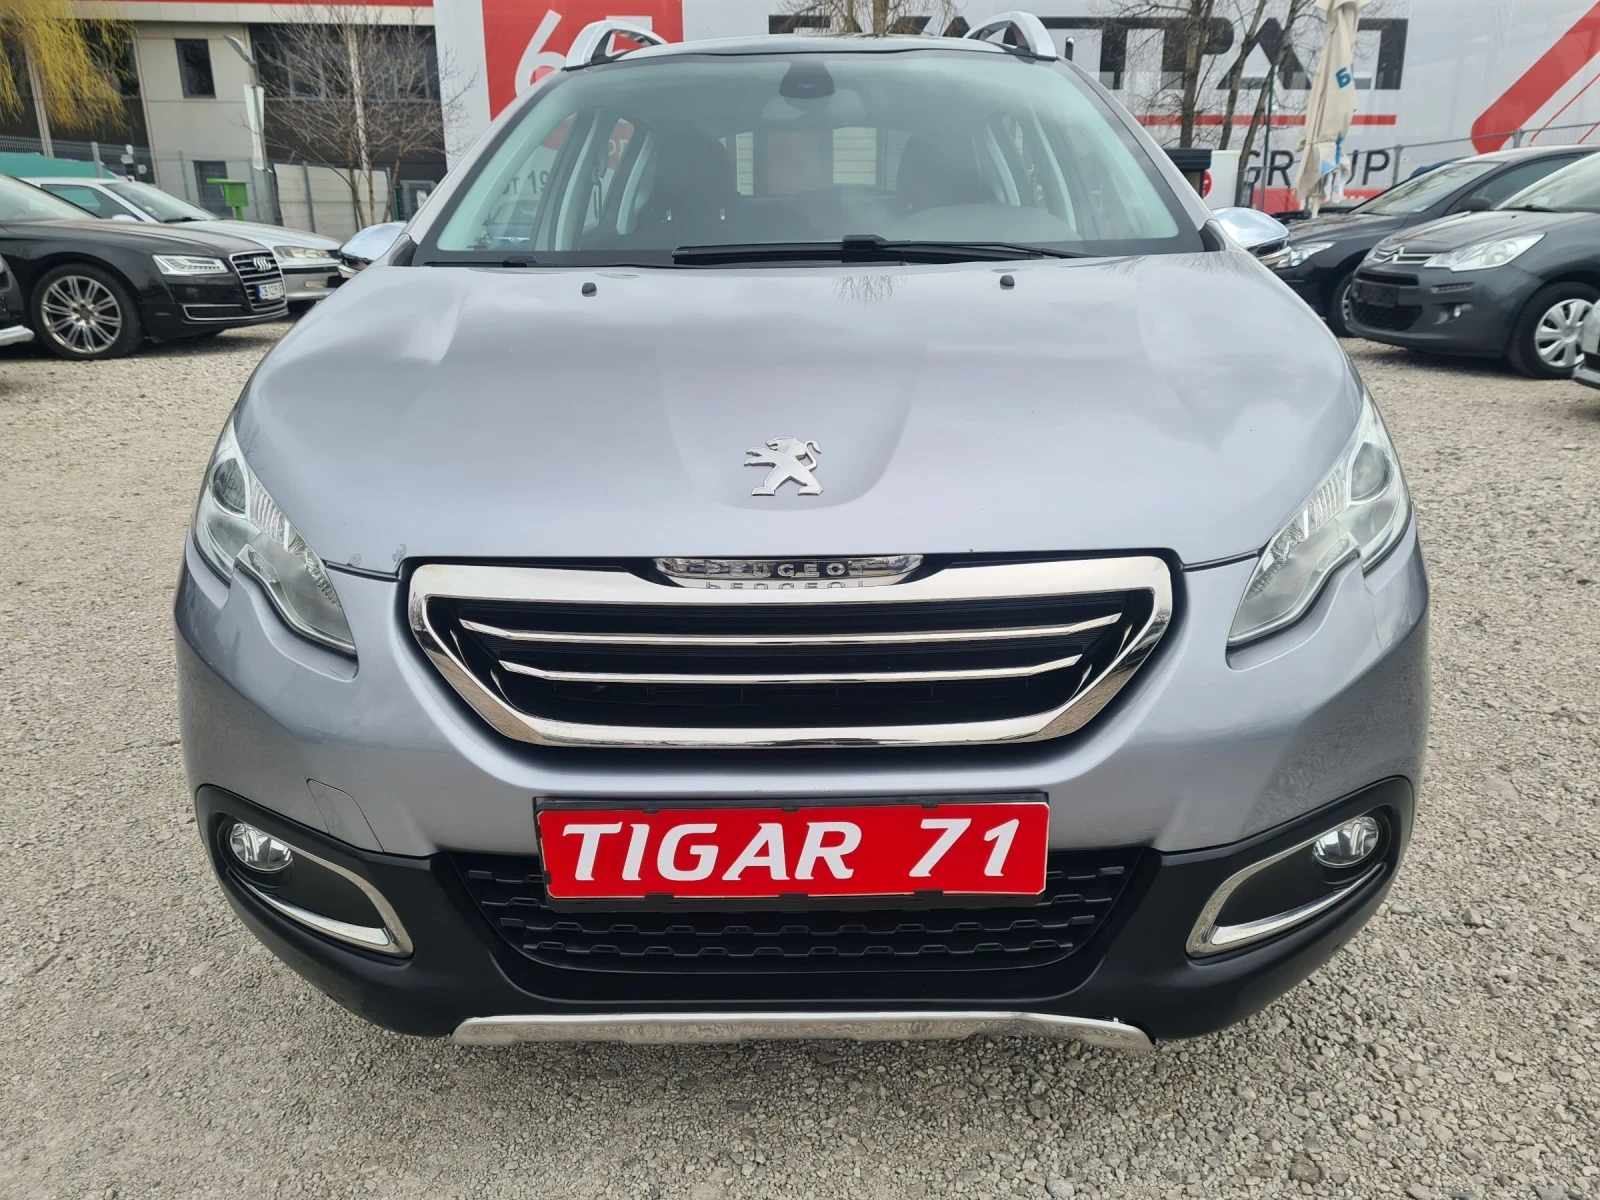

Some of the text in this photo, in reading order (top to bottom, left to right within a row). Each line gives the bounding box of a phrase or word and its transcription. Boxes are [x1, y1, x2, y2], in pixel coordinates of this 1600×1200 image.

[1242, 149, 1391, 187] GRUP
[703, 561, 866, 579] PEUGEOT
[561, 818, 1020, 882] TIGAR 71
